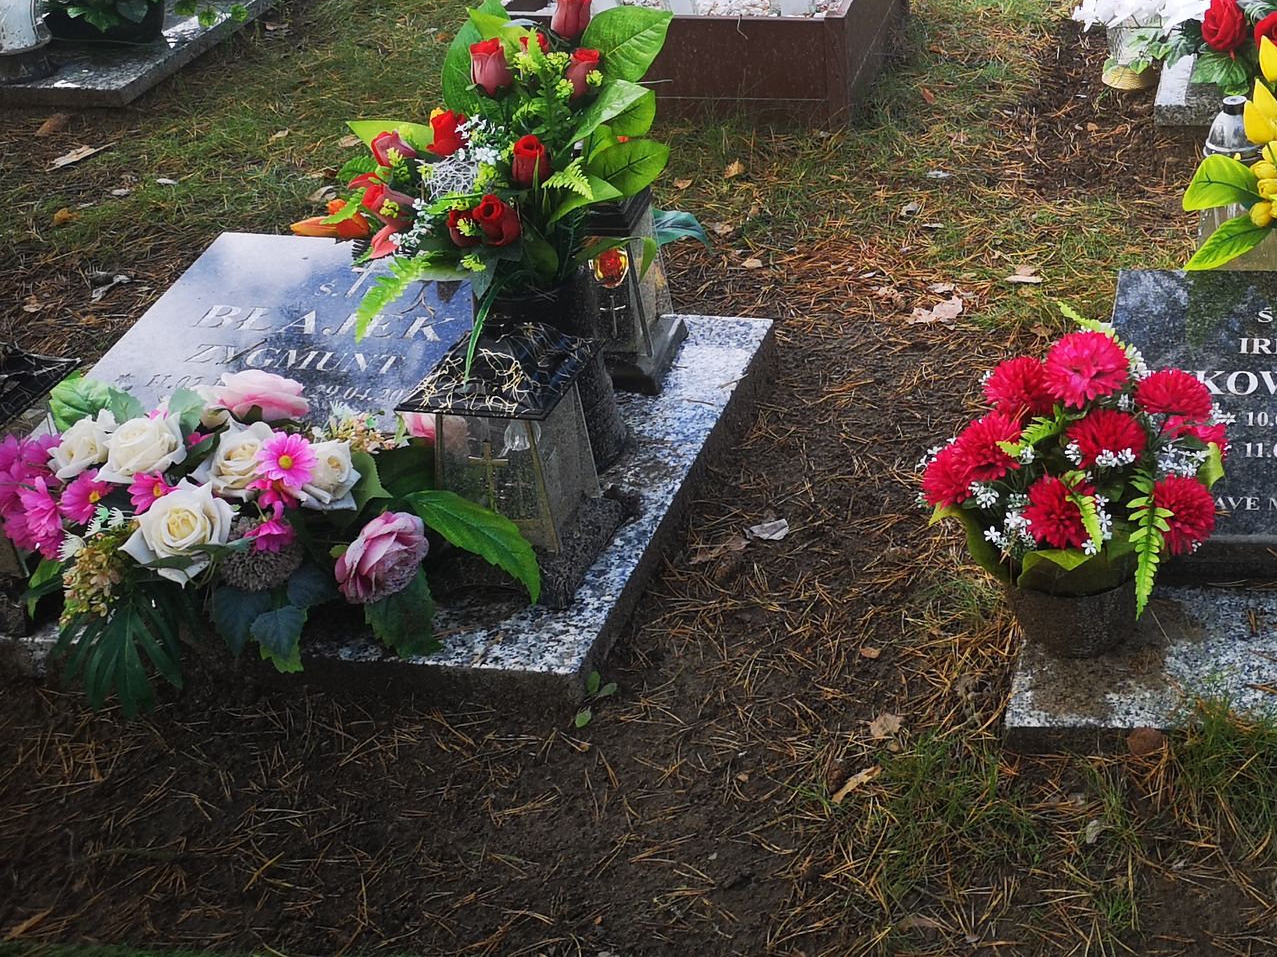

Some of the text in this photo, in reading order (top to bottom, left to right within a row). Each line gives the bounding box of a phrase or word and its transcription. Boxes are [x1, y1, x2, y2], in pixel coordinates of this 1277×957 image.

[1257, 307, 1274, 324] Ś
[184, 343, 405, 375] ZYGMUNT
[1213, 496, 1261, 511] AVE
